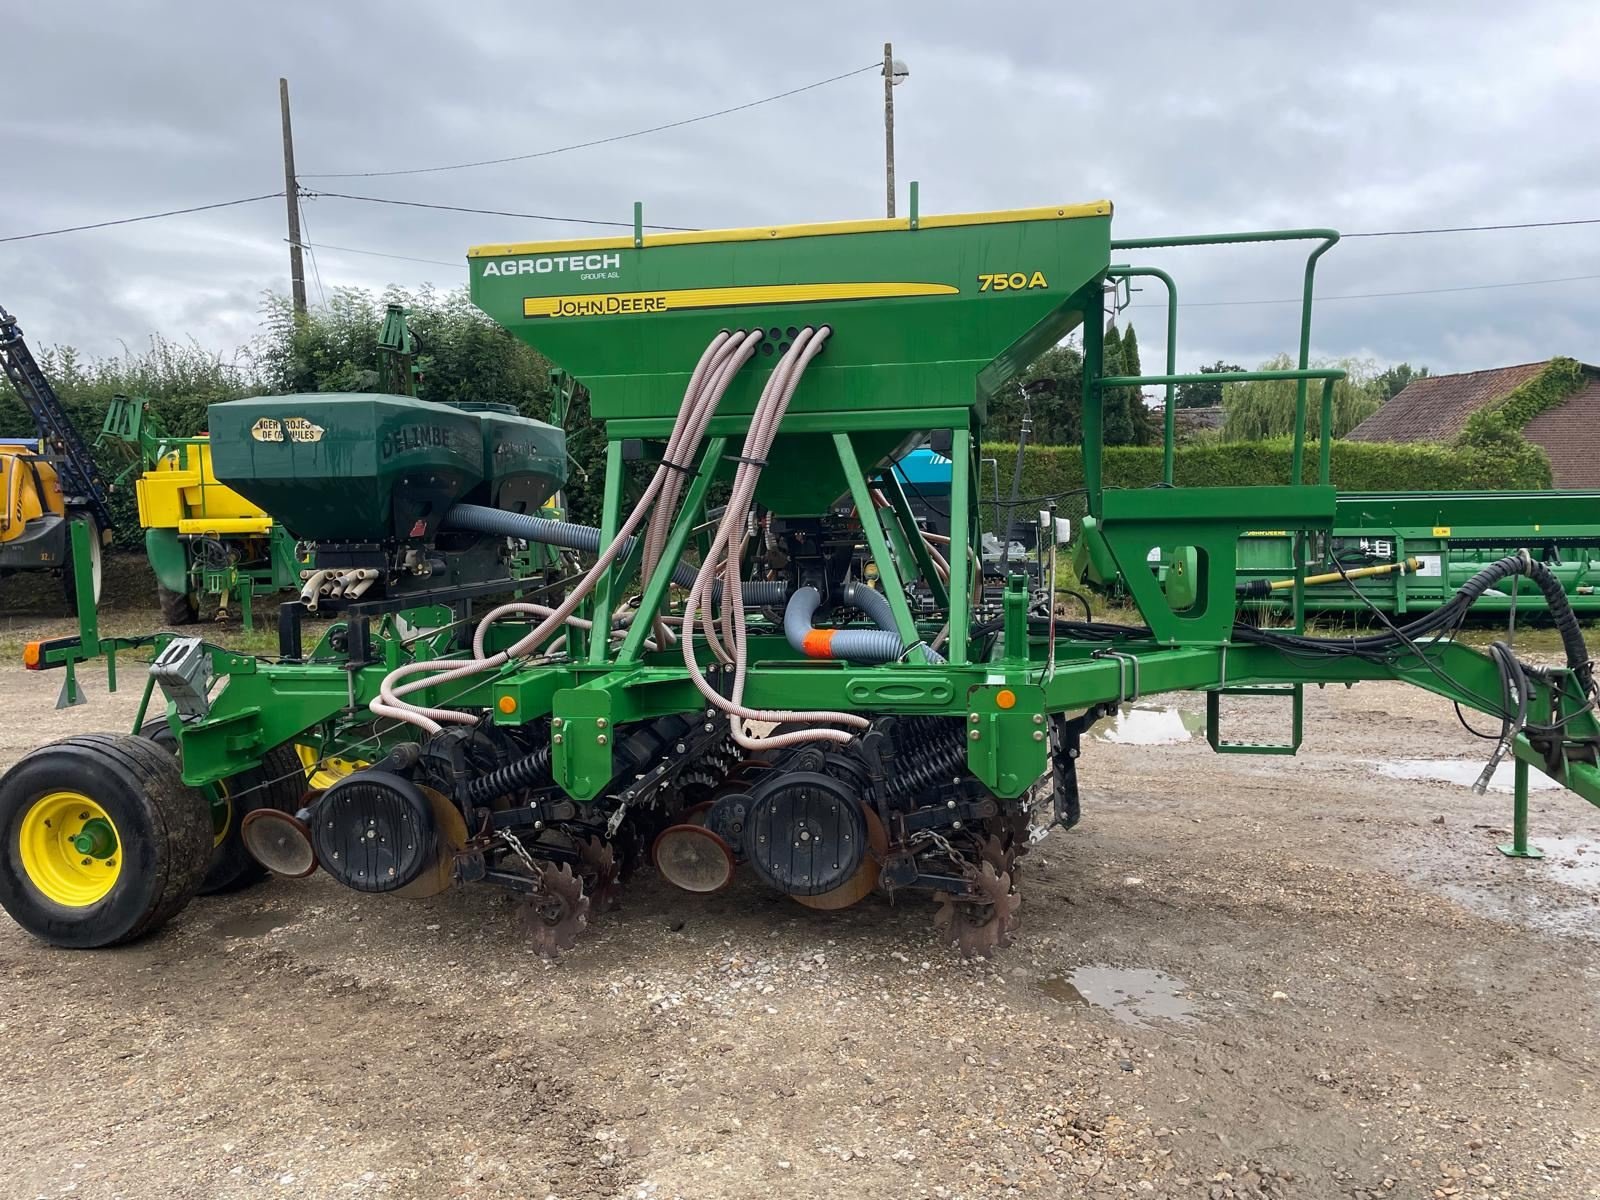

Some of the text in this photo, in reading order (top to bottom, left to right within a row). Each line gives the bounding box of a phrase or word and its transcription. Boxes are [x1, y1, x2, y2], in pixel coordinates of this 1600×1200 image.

[483, 253, 621, 277] AGROTECH
[580, 271, 620, 281] GROUPE ASL
[552, 296, 667, 316] JOHN DEERE
[262, 430, 272, 439] DE
